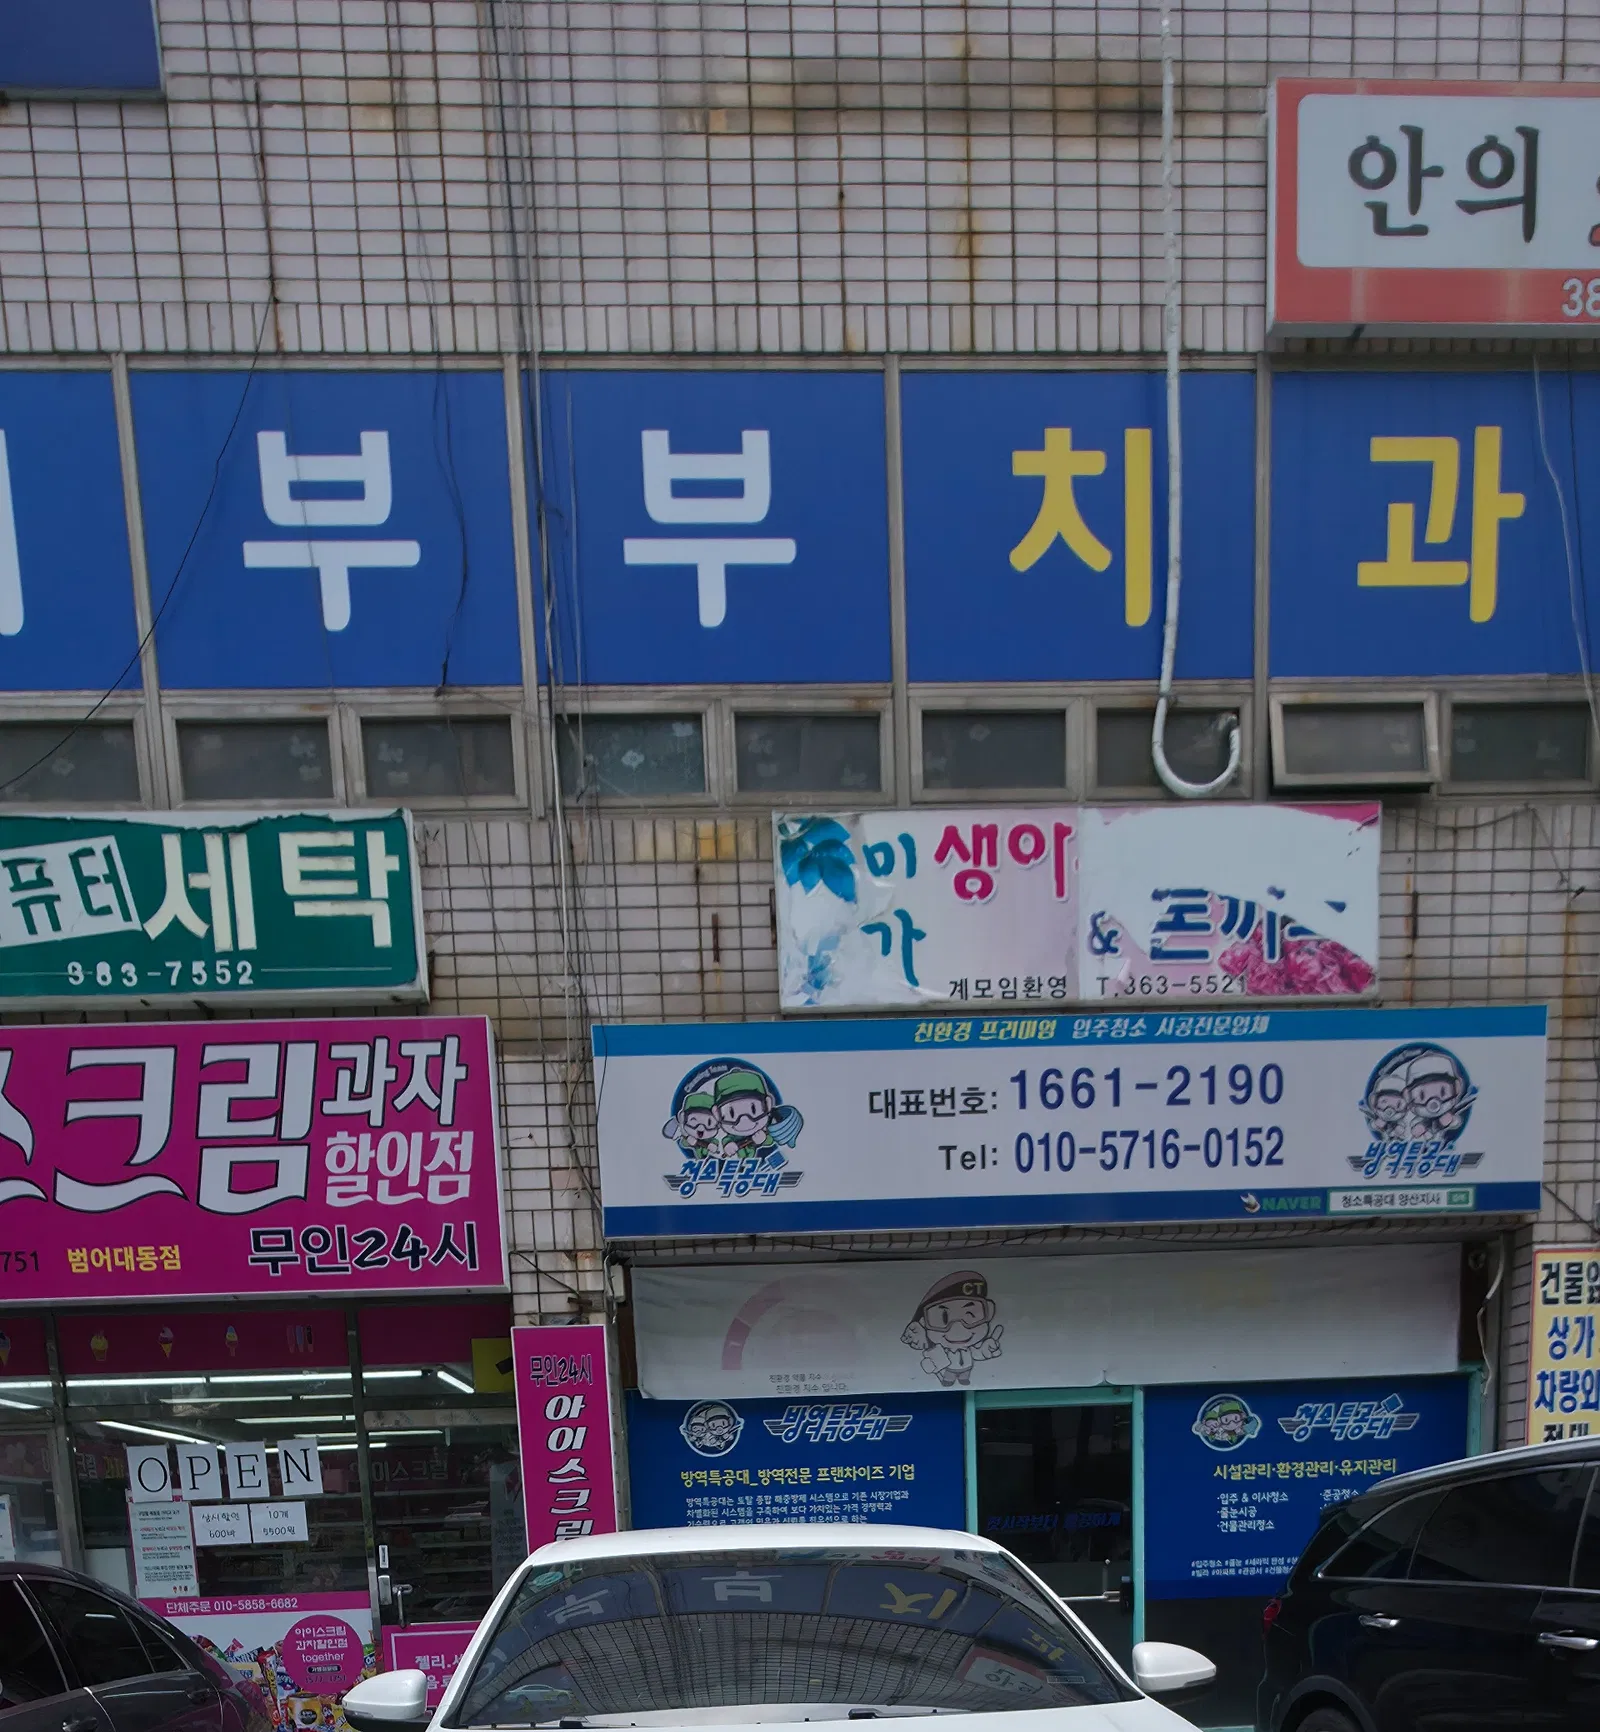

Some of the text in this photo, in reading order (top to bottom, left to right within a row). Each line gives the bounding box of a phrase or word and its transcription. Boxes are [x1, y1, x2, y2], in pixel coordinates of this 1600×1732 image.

[1347, 124, 1540, 244] 안의
[934, 822, 1079, 901] 생아
[143, 830, 400, 953] 세탁
[949, 976, 1067, 1000] 계모임환영
[914, 1015, 1271, 1042] 친환경 프리미엄 입주청소 시공전문업체
[321, 1034, 469, 1128] 과자
[1009, 1063, 1284, 1110] 1661-2190
[938, 1126, 1284, 1173] Tel: 010-5716-0152
[325, 1130, 474, 1208] 할인점
[1262, 1196, 1321, 1211] NAVER
[67, 1245, 181, 1273] 범어대동점
[248, 1220, 480, 1277] 무인24시
[962, 1282, 984, 1296] CT
[1547, 1315, 1595, 1361] 상가
[529, 1353, 593, 1387] 무인24시
[138, 1448, 314, 1493] OPEN
[816, 1466, 885, 1483] 프랜차이즈
[889, 1464, 915, 1481] 기업
[686, 1496, 734, 1507] 방역특공대는
[809, 1492, 849, 1503] 시스템으로
[852, 1491, 867, 1502] 기존
[791, 1505, 807, 1515] 보다
[809, 1504, 841, 1515] 가치있는
[843, 1503, 859, 1513] 가격
[1242, 1494, 1249, 1503] &
[1252, 1491, 1289, 1503] 이사청소
[166, 1602, 211, 1614] 단체주문
[295, 1626, 346, 1638] 아이스크림
[296, 1638, 348, 1651] 과자할인점
[302, 1652, 345, 1664] together
